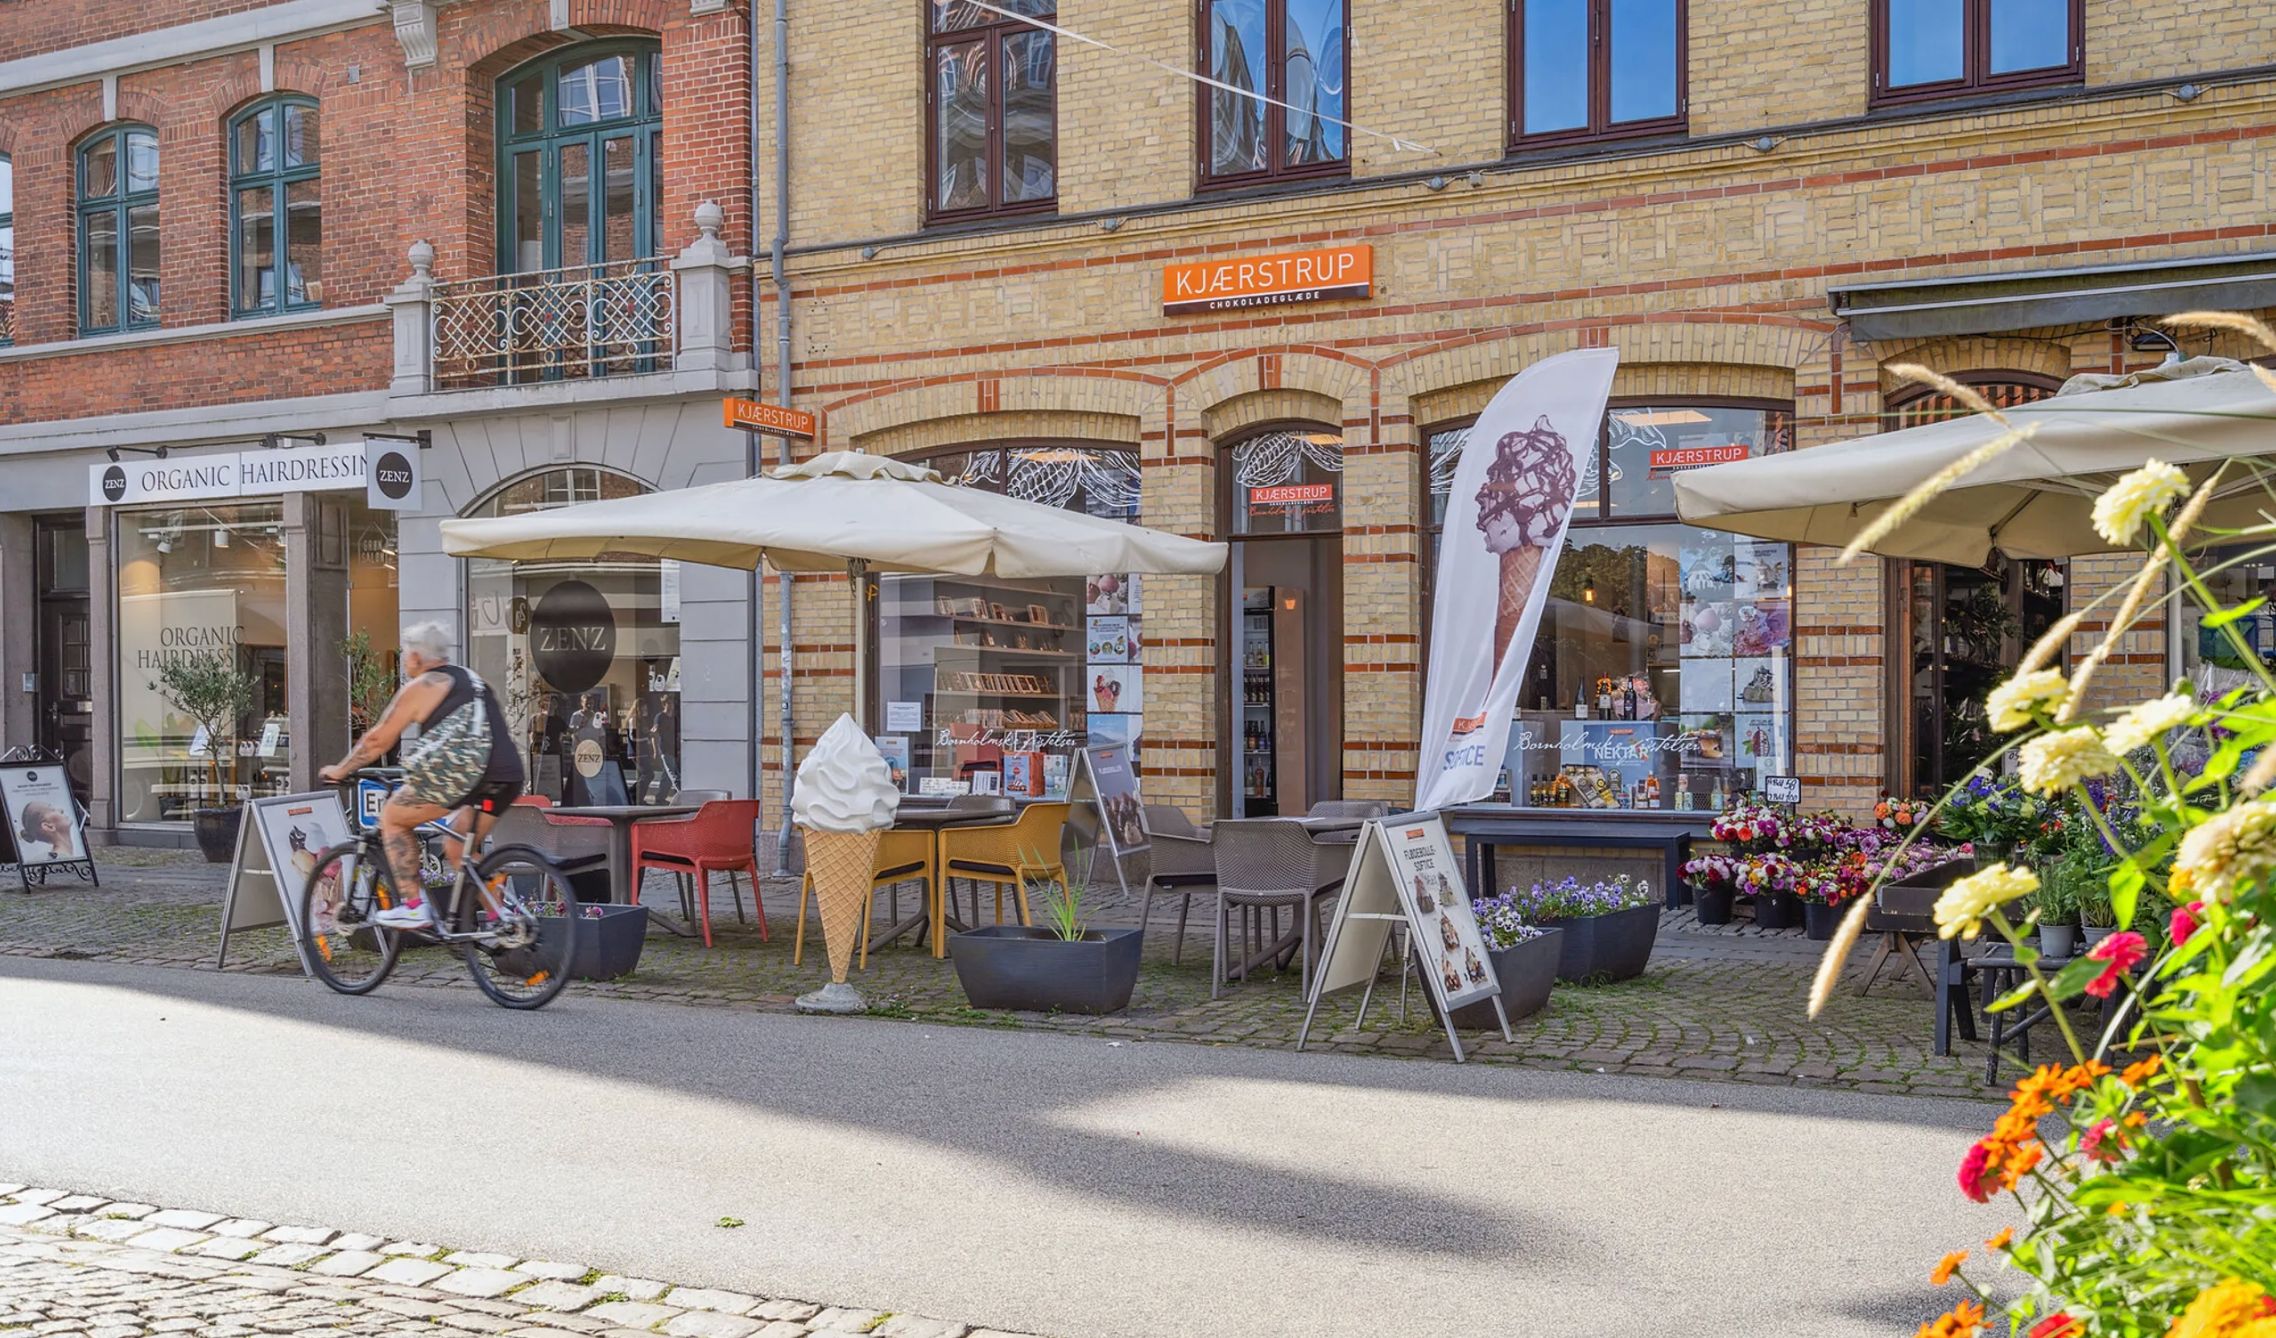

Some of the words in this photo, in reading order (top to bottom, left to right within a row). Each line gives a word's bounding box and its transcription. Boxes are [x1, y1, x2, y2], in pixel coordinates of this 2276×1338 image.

[1176, 252, 1355, 296] KJÆRSTRUP
[1209, 290, 1320, 310] CHOKOLADEGLÆDE
[737, 402, 809, 430] KJÆRSTRUP
[1656, 447, 1742, 464] KJÆRSTRUP
[104, 477, 126, 489] ZENZ
[141, 464, 231, 492] ORGANIC
[241, 454, 368, 485] HAIRDRESSIN
[379, 470, 410, 484] ZENZ
[1255, 486, 1328, 500] KJÆRSTRUP
[160, 625, 245, 647] ORGANIC
[539, 626, 607, 652] ZENZ
[138, 646, 267, 669] HAIRDRESSNG
[1514, 731, 1624, 751] Bornholmske
[577, 753, 601, 764] ZENZ
[1594, 746, 1649, 761] NEKTAR
